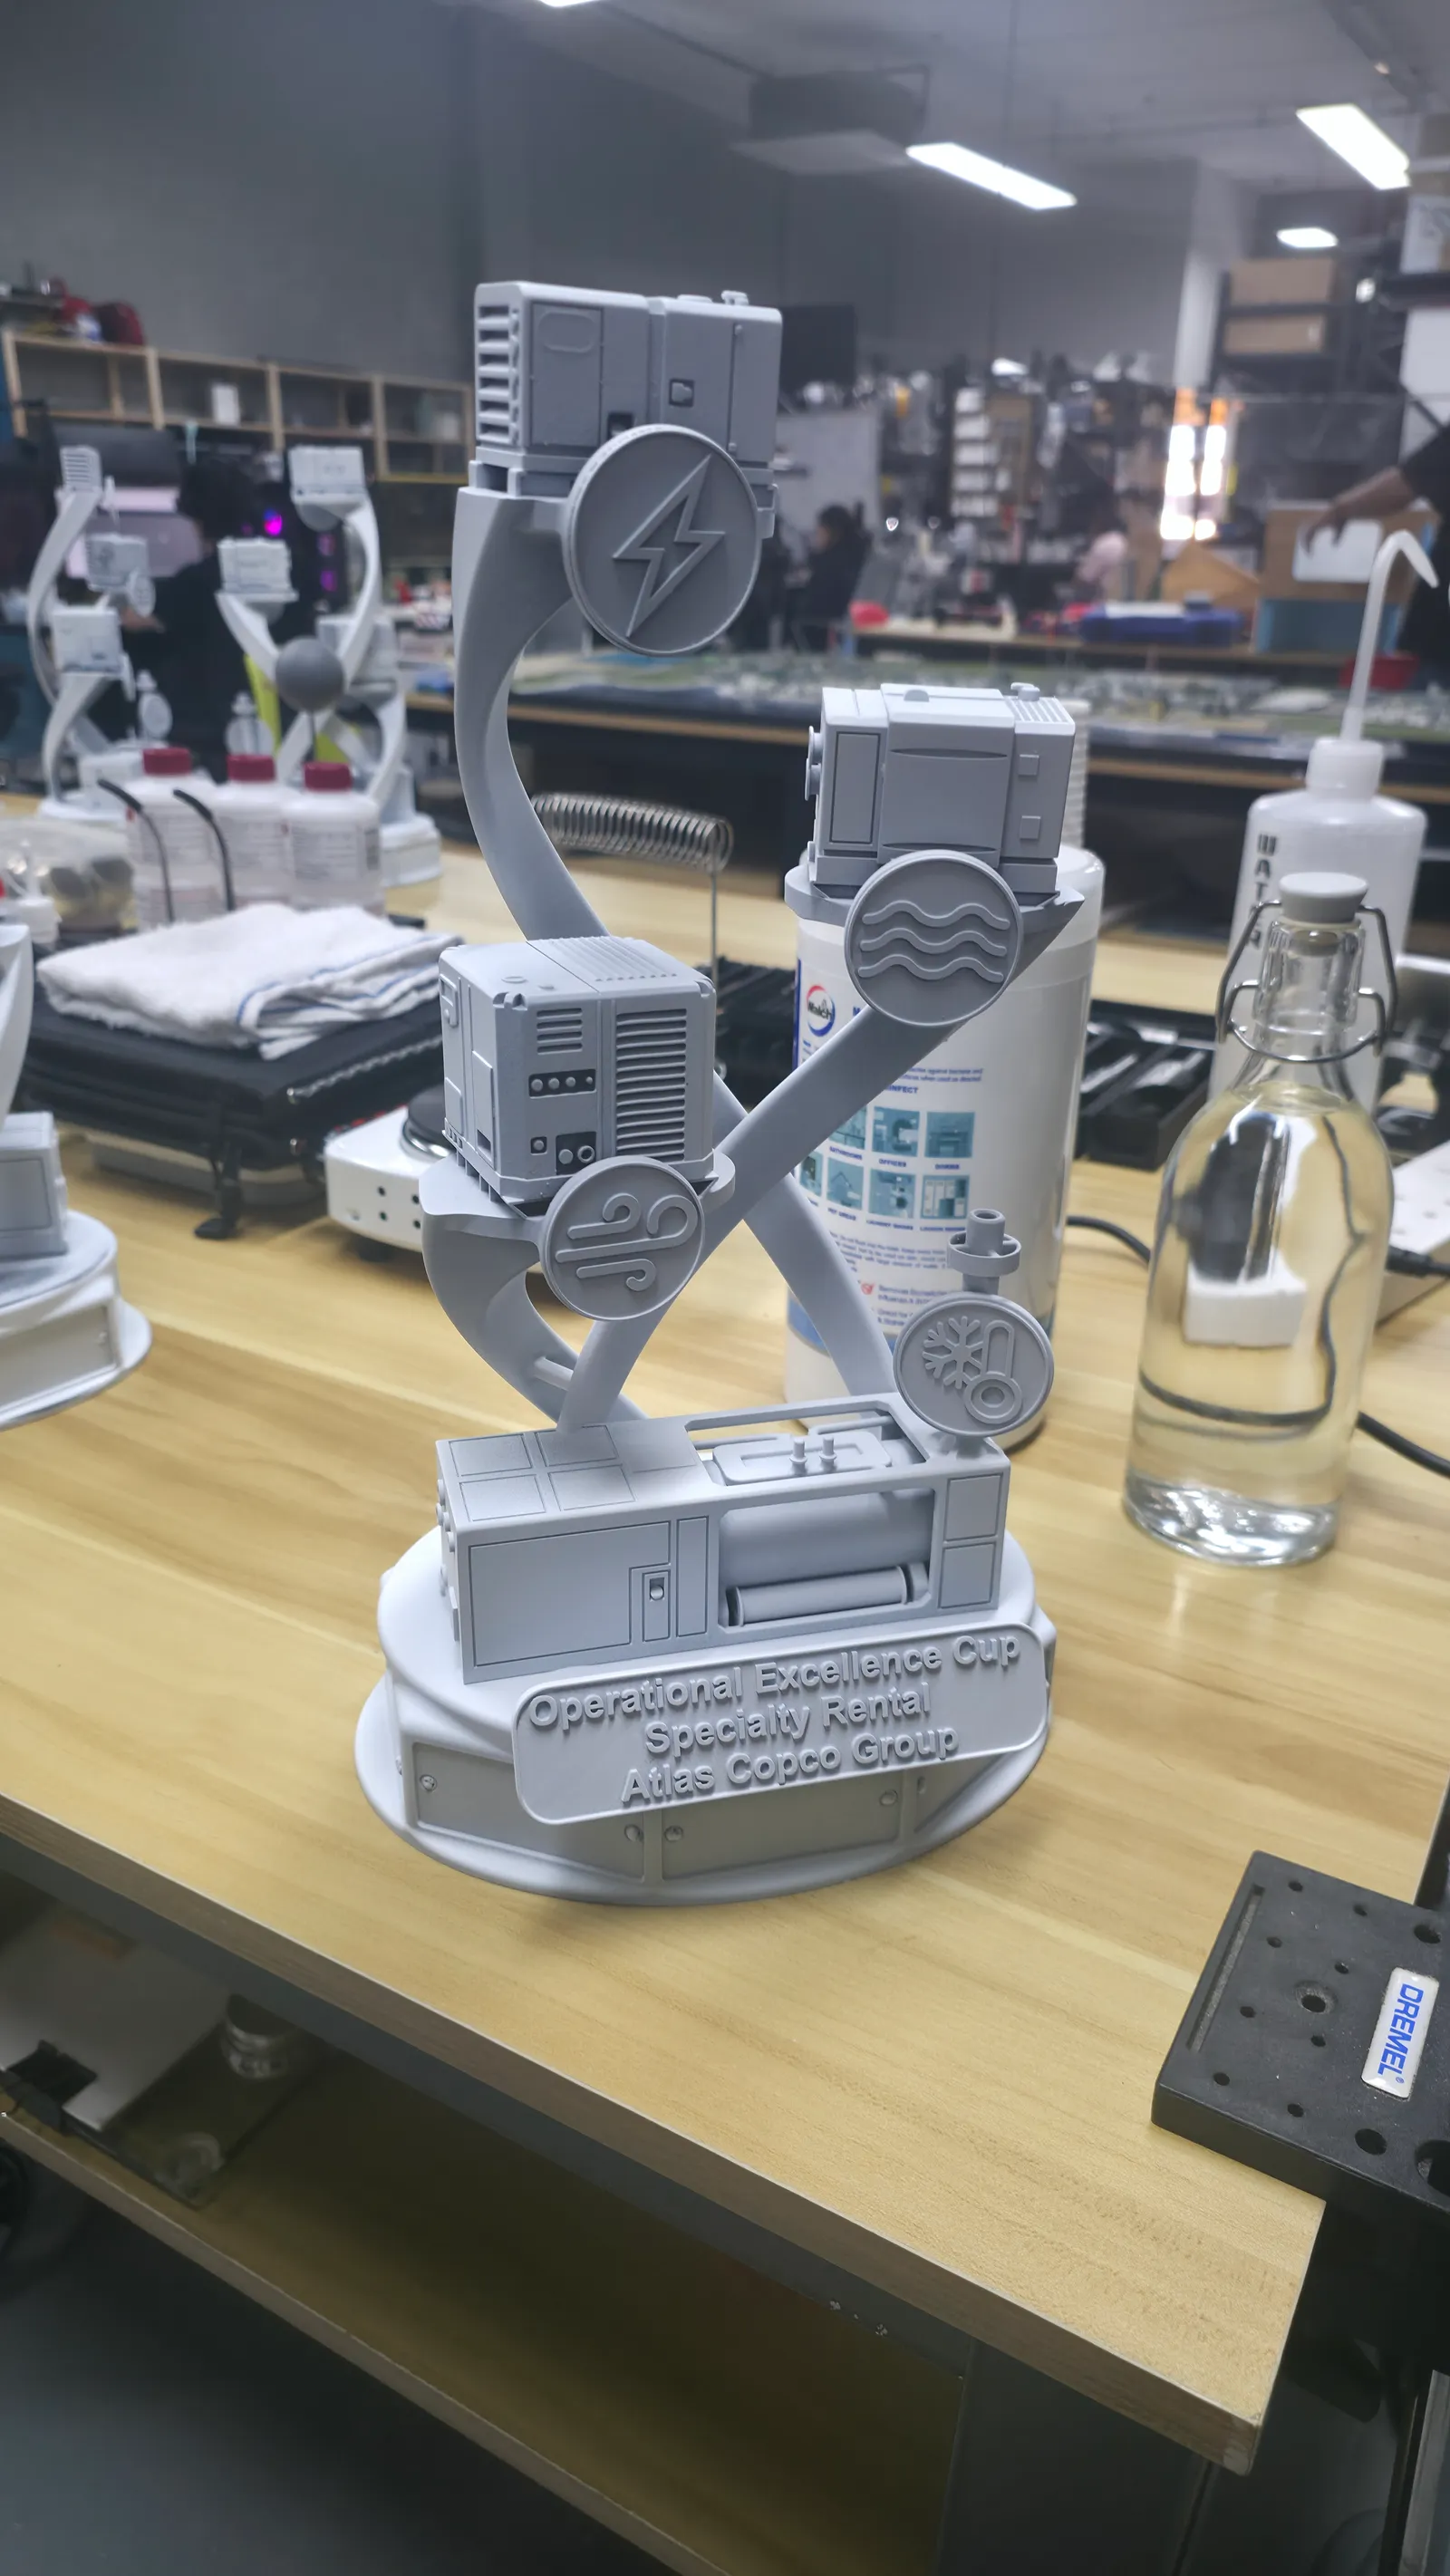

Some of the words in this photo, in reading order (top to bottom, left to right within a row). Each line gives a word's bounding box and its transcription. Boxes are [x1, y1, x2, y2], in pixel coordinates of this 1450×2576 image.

[529, 1666, 743, 1731] Operational
[755, 1645, 943, 1694] Excellence
[952, 1635, 1021, 1667] Cup
[645, 1703, 810, 1758] Specialty
[821, 1681, 932, 1728] Rental
[621, 1763, 716, 1803] Atlas
[727, 1745, 842, 1786] Copco
[851, 1727, 959, 1764] Group
